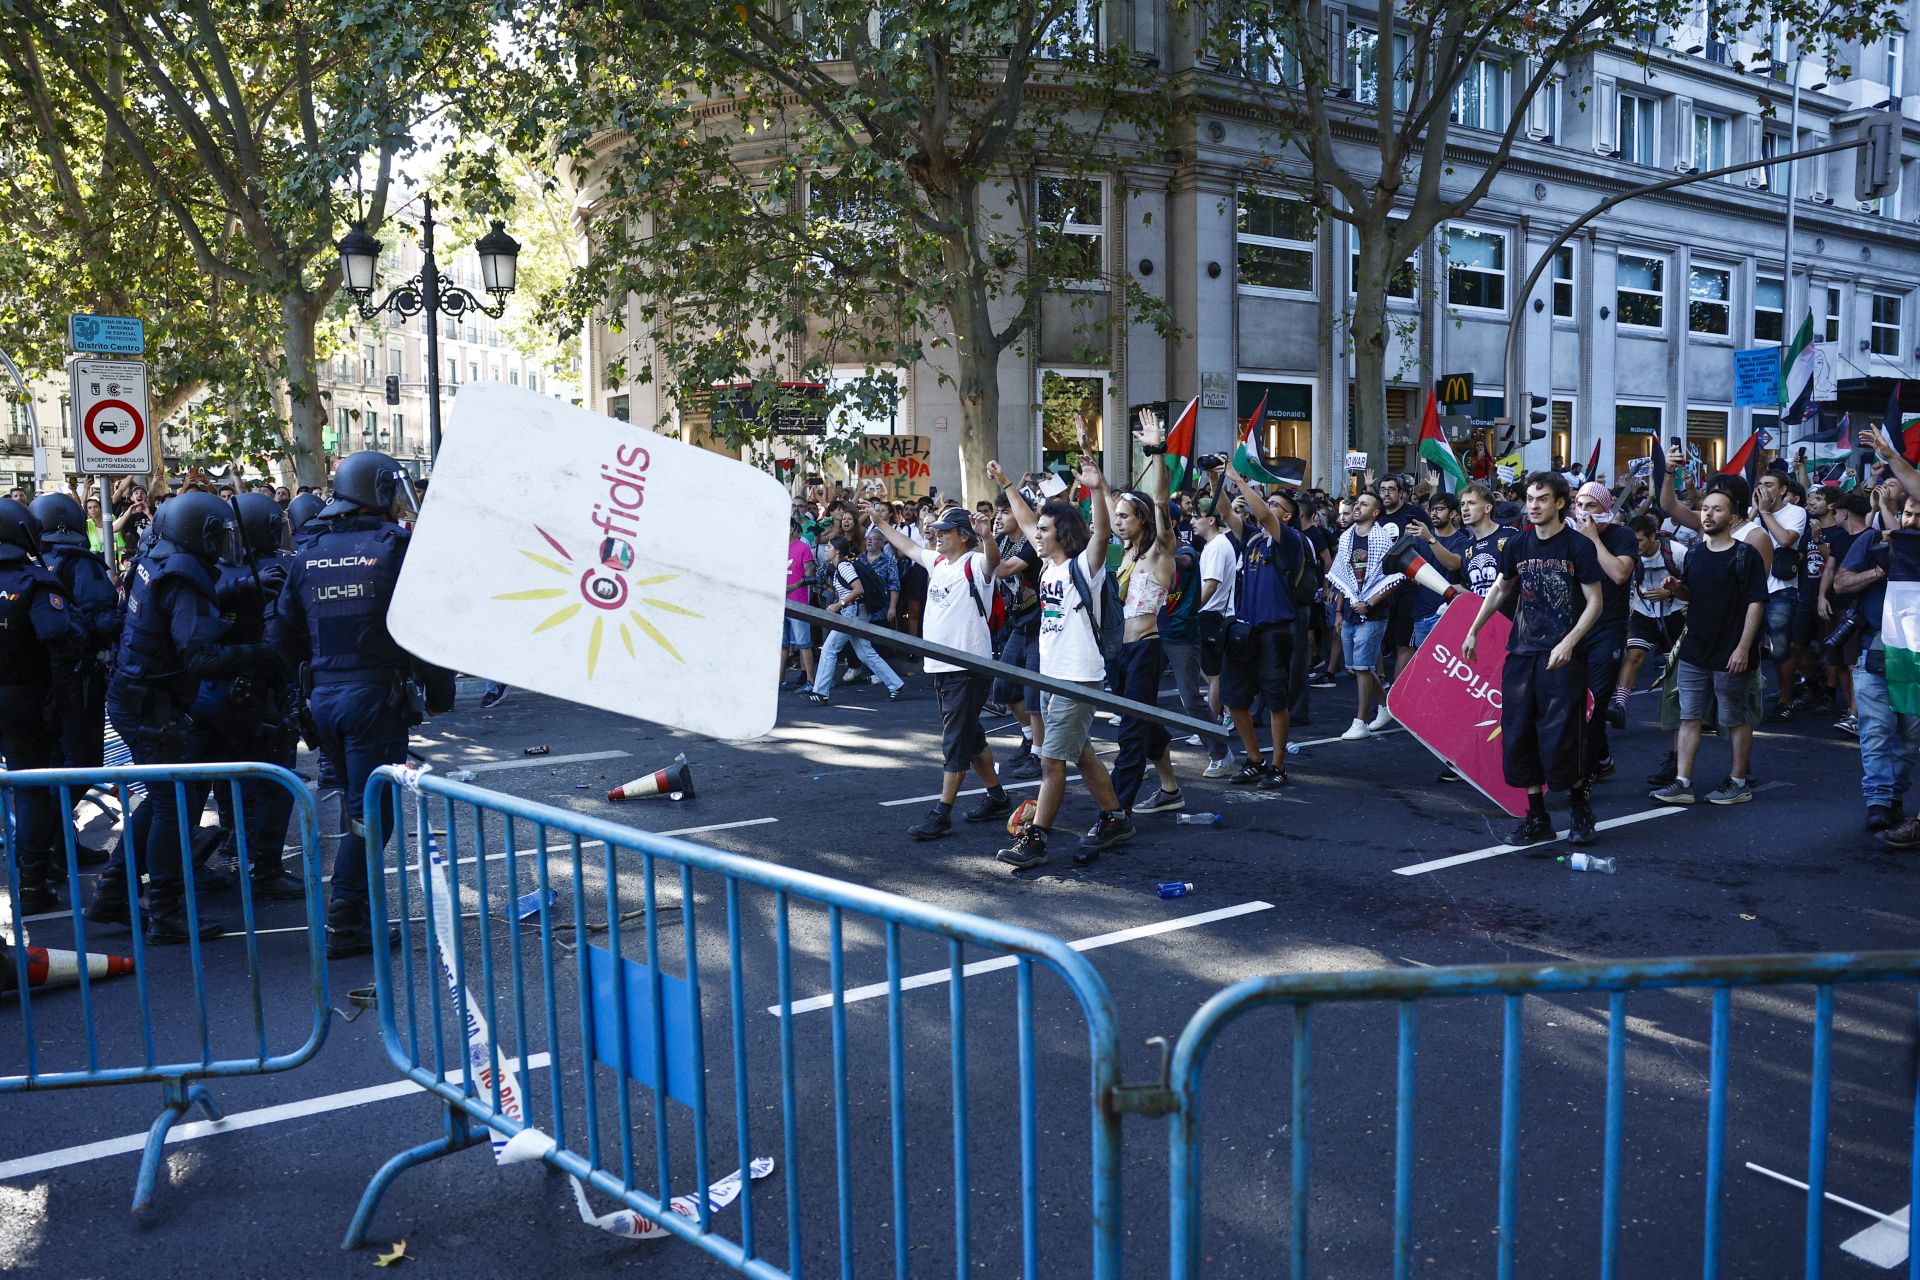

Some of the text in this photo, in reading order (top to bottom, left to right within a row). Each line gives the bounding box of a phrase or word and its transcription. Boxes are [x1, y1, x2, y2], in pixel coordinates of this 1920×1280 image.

[78, 341, 140, 351] Distrito Centro
[1266, 410, 1306, 418] McDonald's
[863, 436, 930, 460] ISRAEL,
[858, 457, 931, 479] MERDA
[1352, 456, 1366, 467] WAR
[305, 555, 368, 570] POLICIA
[317, 583, 364, 600] UC431
[1432, 643, 1503, 709] ofidis
